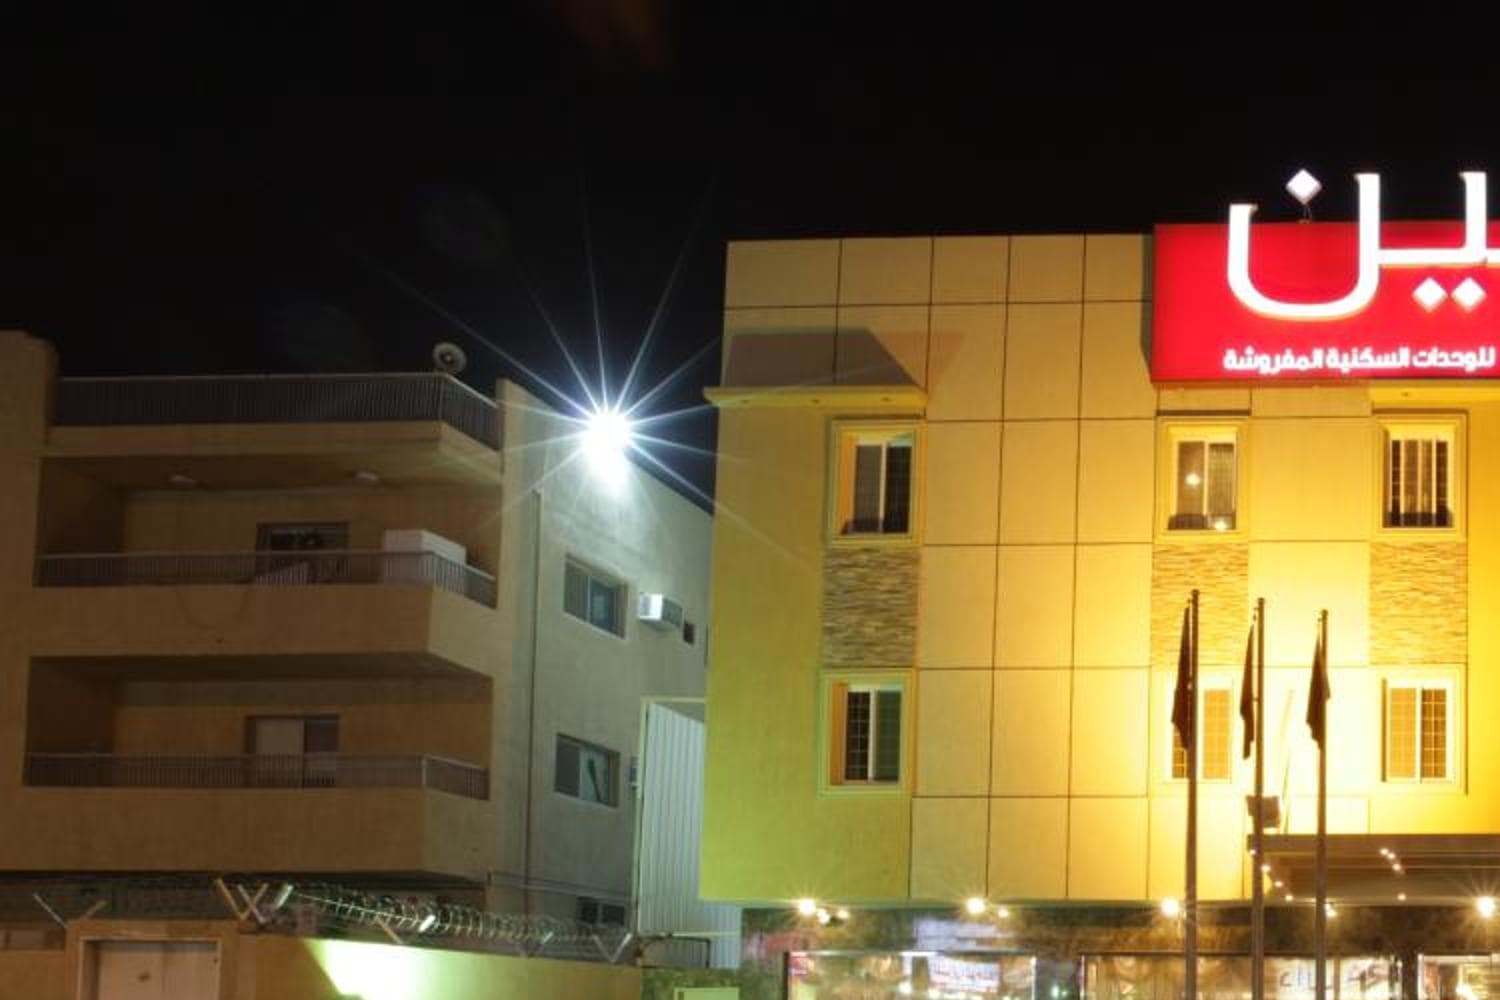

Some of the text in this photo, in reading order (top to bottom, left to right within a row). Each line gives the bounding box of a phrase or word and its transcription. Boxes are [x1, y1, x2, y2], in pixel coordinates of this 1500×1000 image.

[1222, 345, 1497, 375] للوحدات السكنية المفروشة
